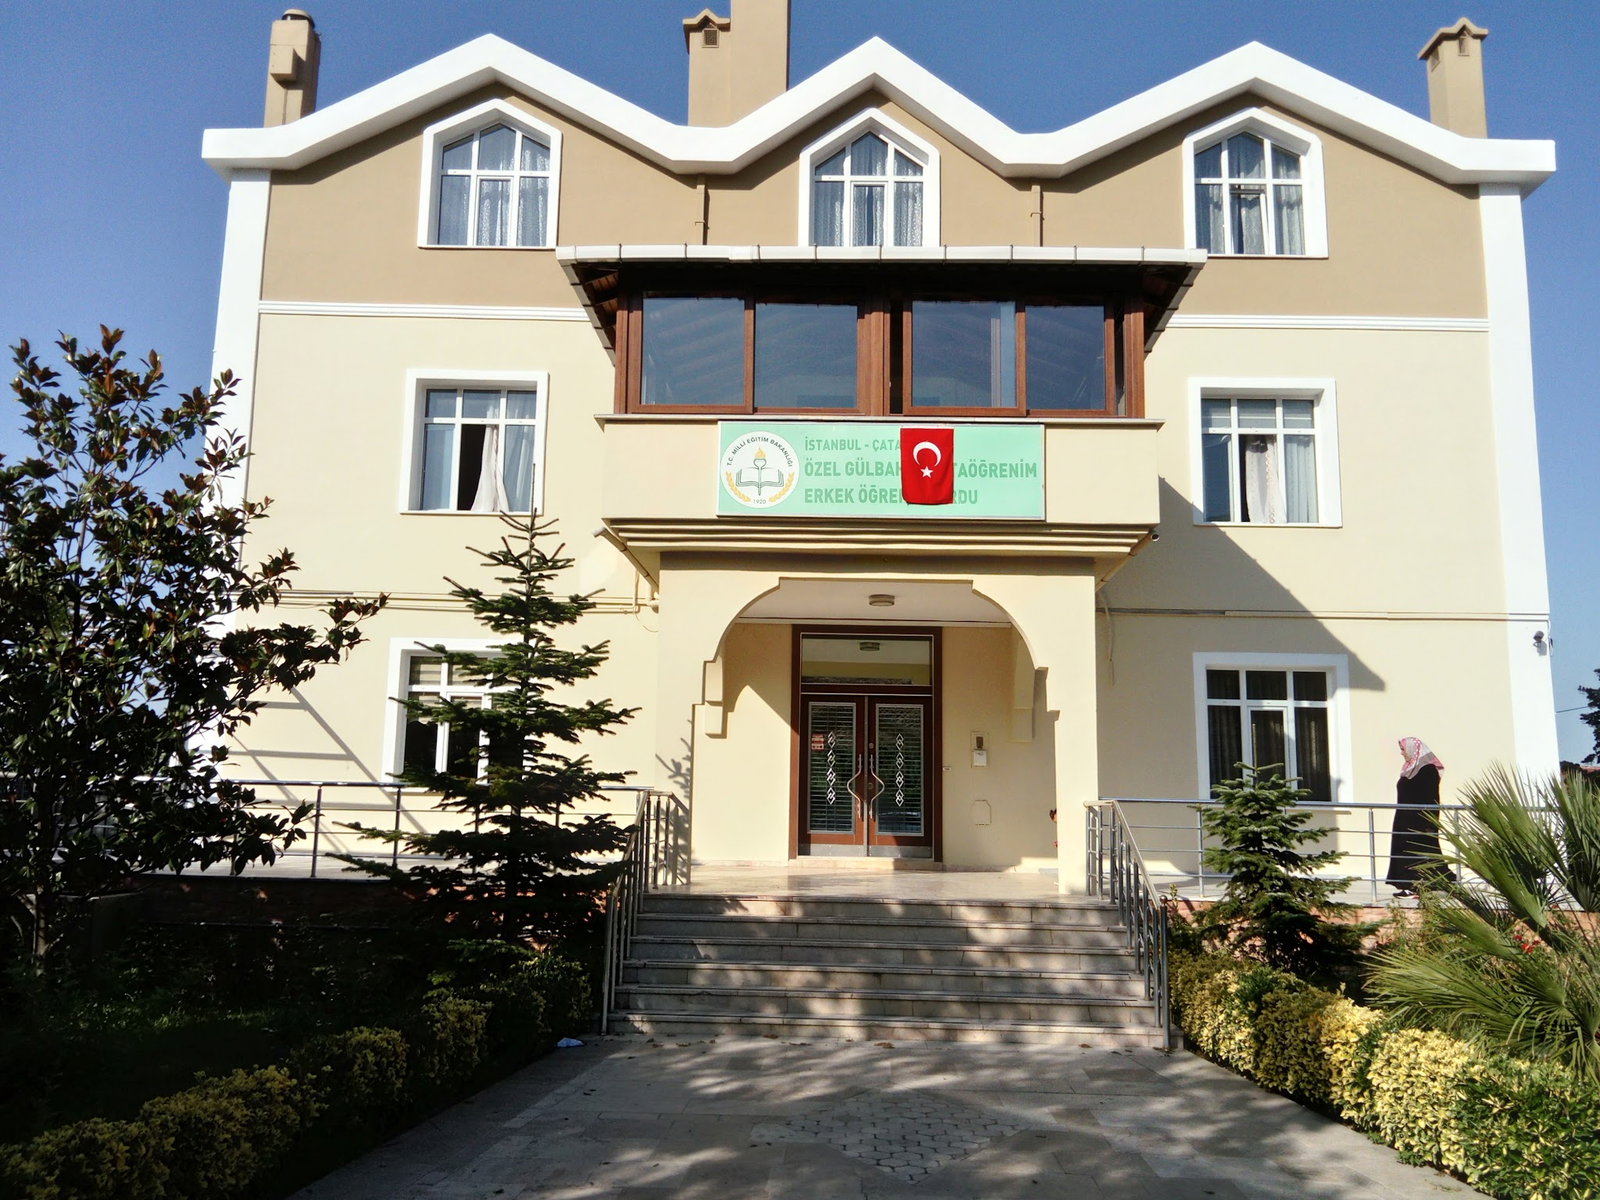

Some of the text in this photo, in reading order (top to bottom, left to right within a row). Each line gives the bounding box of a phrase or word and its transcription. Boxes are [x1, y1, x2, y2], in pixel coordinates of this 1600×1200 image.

[805, 436, 862, 451] İSTANBUL
[872, 439, 900, 452] ÇATA
[804, 457, 841, 477] ÖZEL
[804, 488, 855, 504] ERKEK
